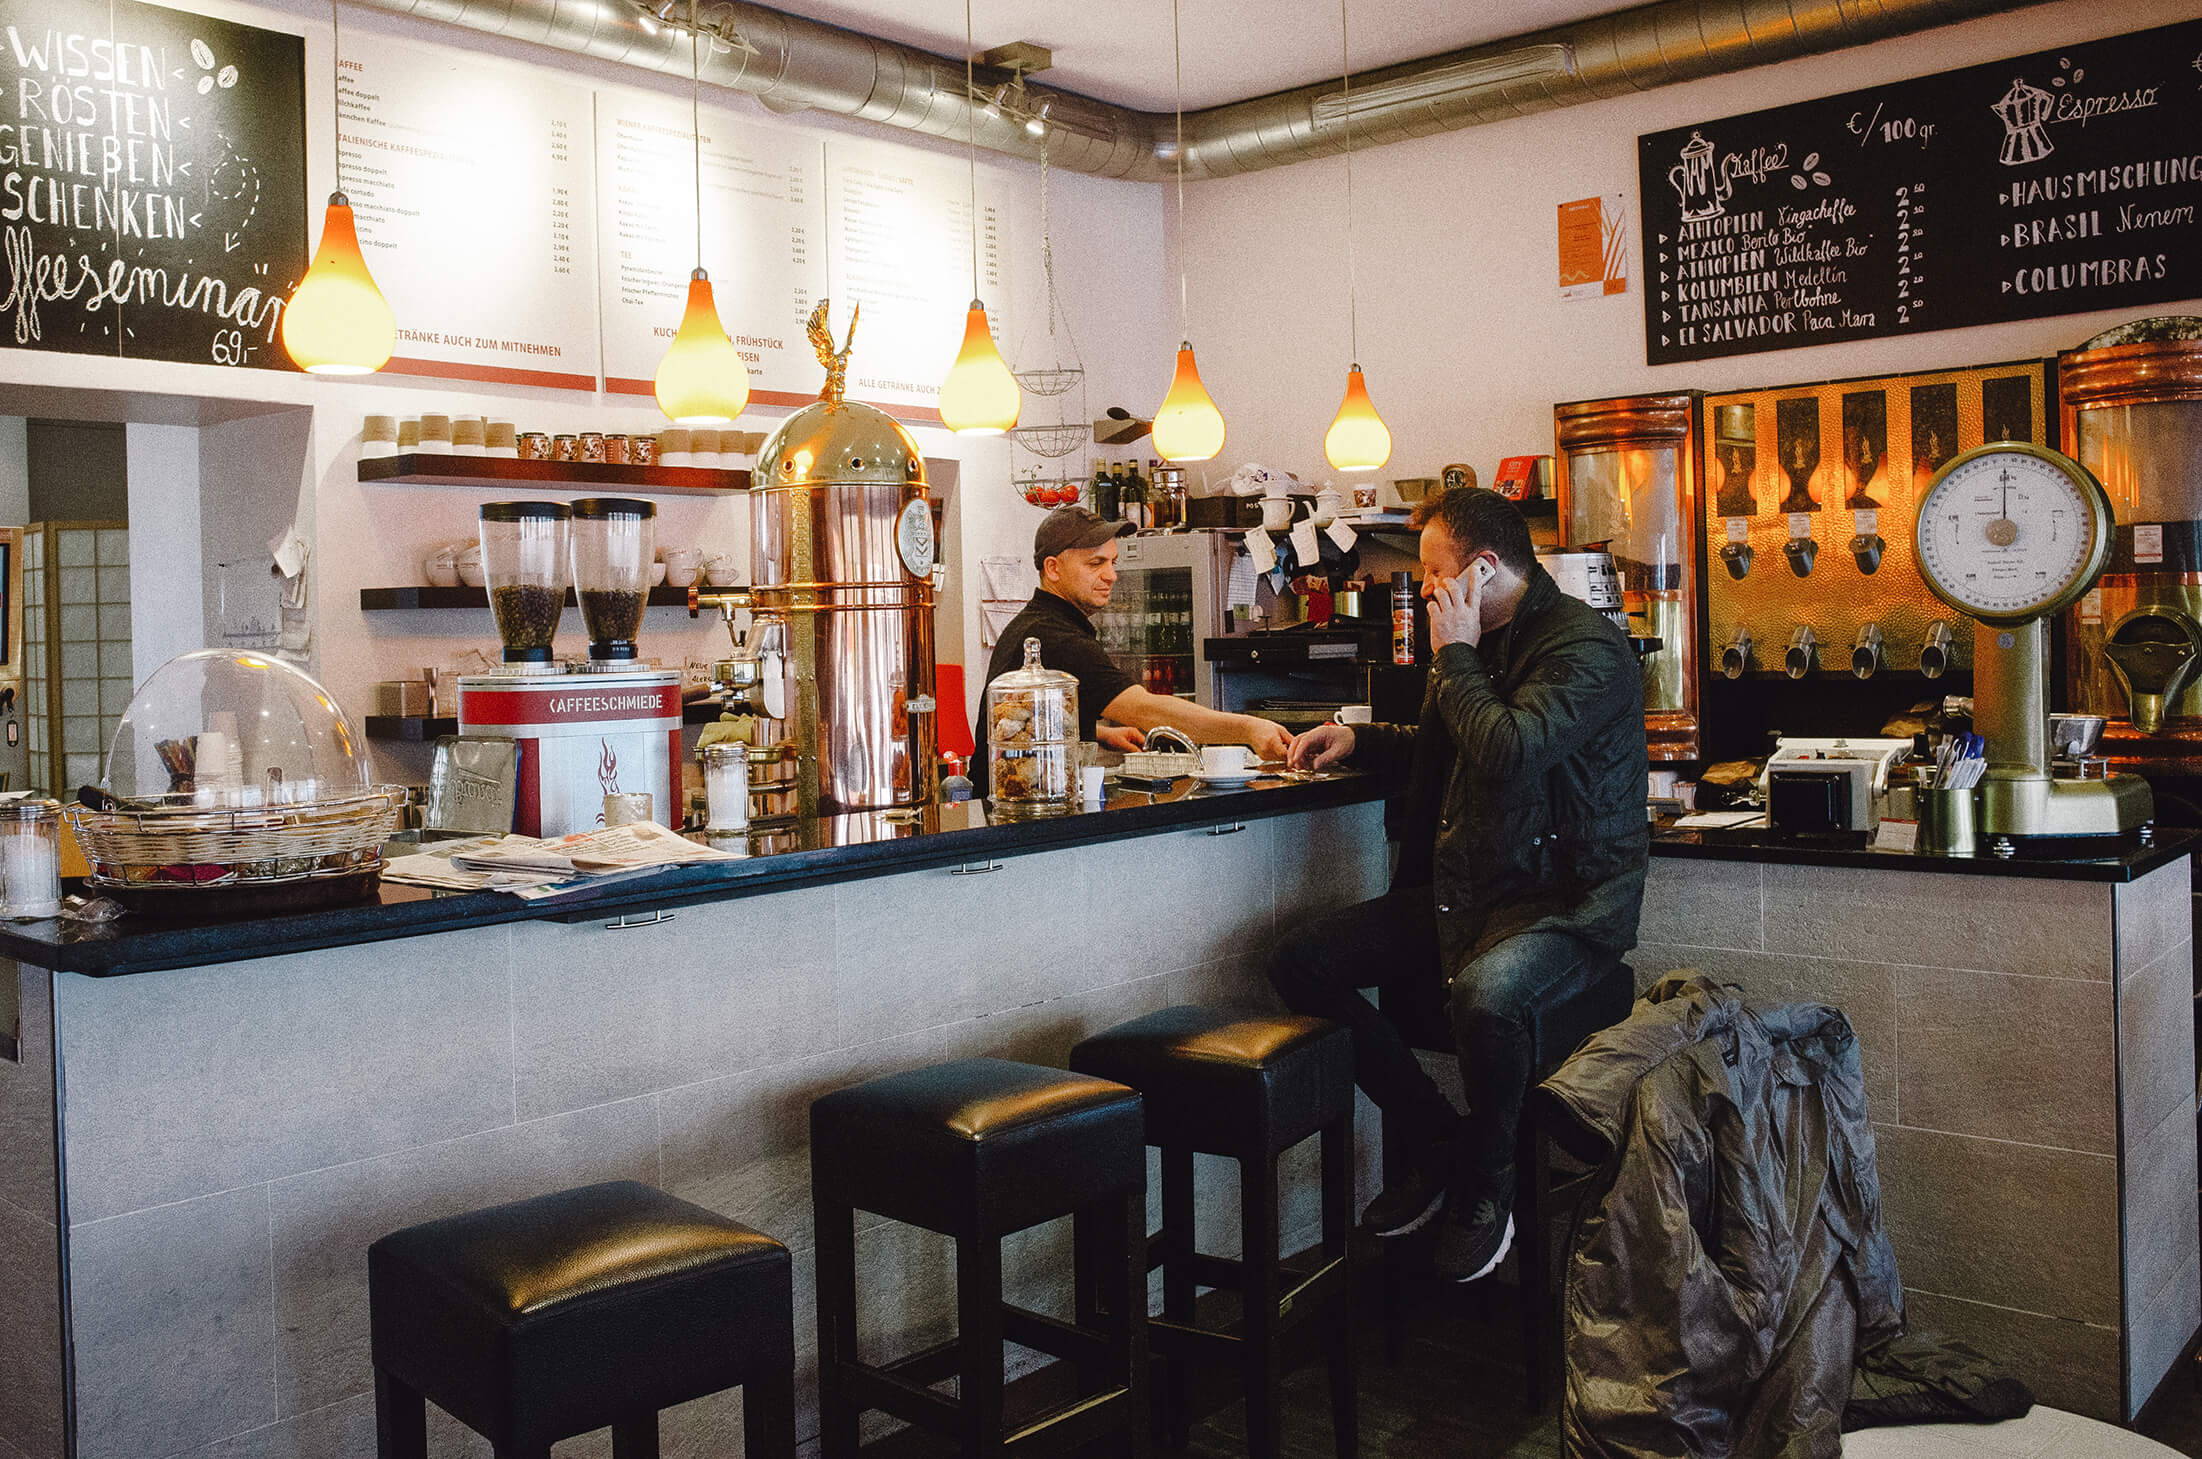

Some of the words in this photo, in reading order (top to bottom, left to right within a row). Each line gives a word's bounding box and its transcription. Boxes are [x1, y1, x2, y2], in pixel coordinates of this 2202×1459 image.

[7, 26, 165, 90] WISSEN
[338, 75, 354, 83] affee
[338, 87, 354, 97] affee
[19, 74, 171, 141] RÖSTEN
[2056, 86, 2159, 128] Espresso
[2012, 155, 2202, 208] HAUSMISCHUNG
[1, 172, 185, 240] SCHENKEN
[2013, 211, 2103, 248] BRASIL
[2116, 203, 2194, 234] Nenem
[1678, 238, 1736, 263] MEXICO
[1781, 226, 1807, 246] Bio
[1773, 239, 1842, 268] Wildkaffee
[1844, 236, 1870, 258] Bio
[1678, 270, 1778, 303] KOLUMBIEN
[2015, 253, 2168, 296] COLUMBRAS
[1678, 293, 1769, 324] TANSANIA
[443, 335, 472, 347] AUCH
[475, 338, 498, 350] ZUM
[501, 341, 561, 357] MITNEHMEN
[736, 334, 784, 350] FRÜHSTÜCK
[1679, 326, 1698, 347] EL
[1702, 311, 1798, 345] SALVADOR
[1803, 310, 1836, 333] Paca
[858, 378, 876, 388] ALLE
